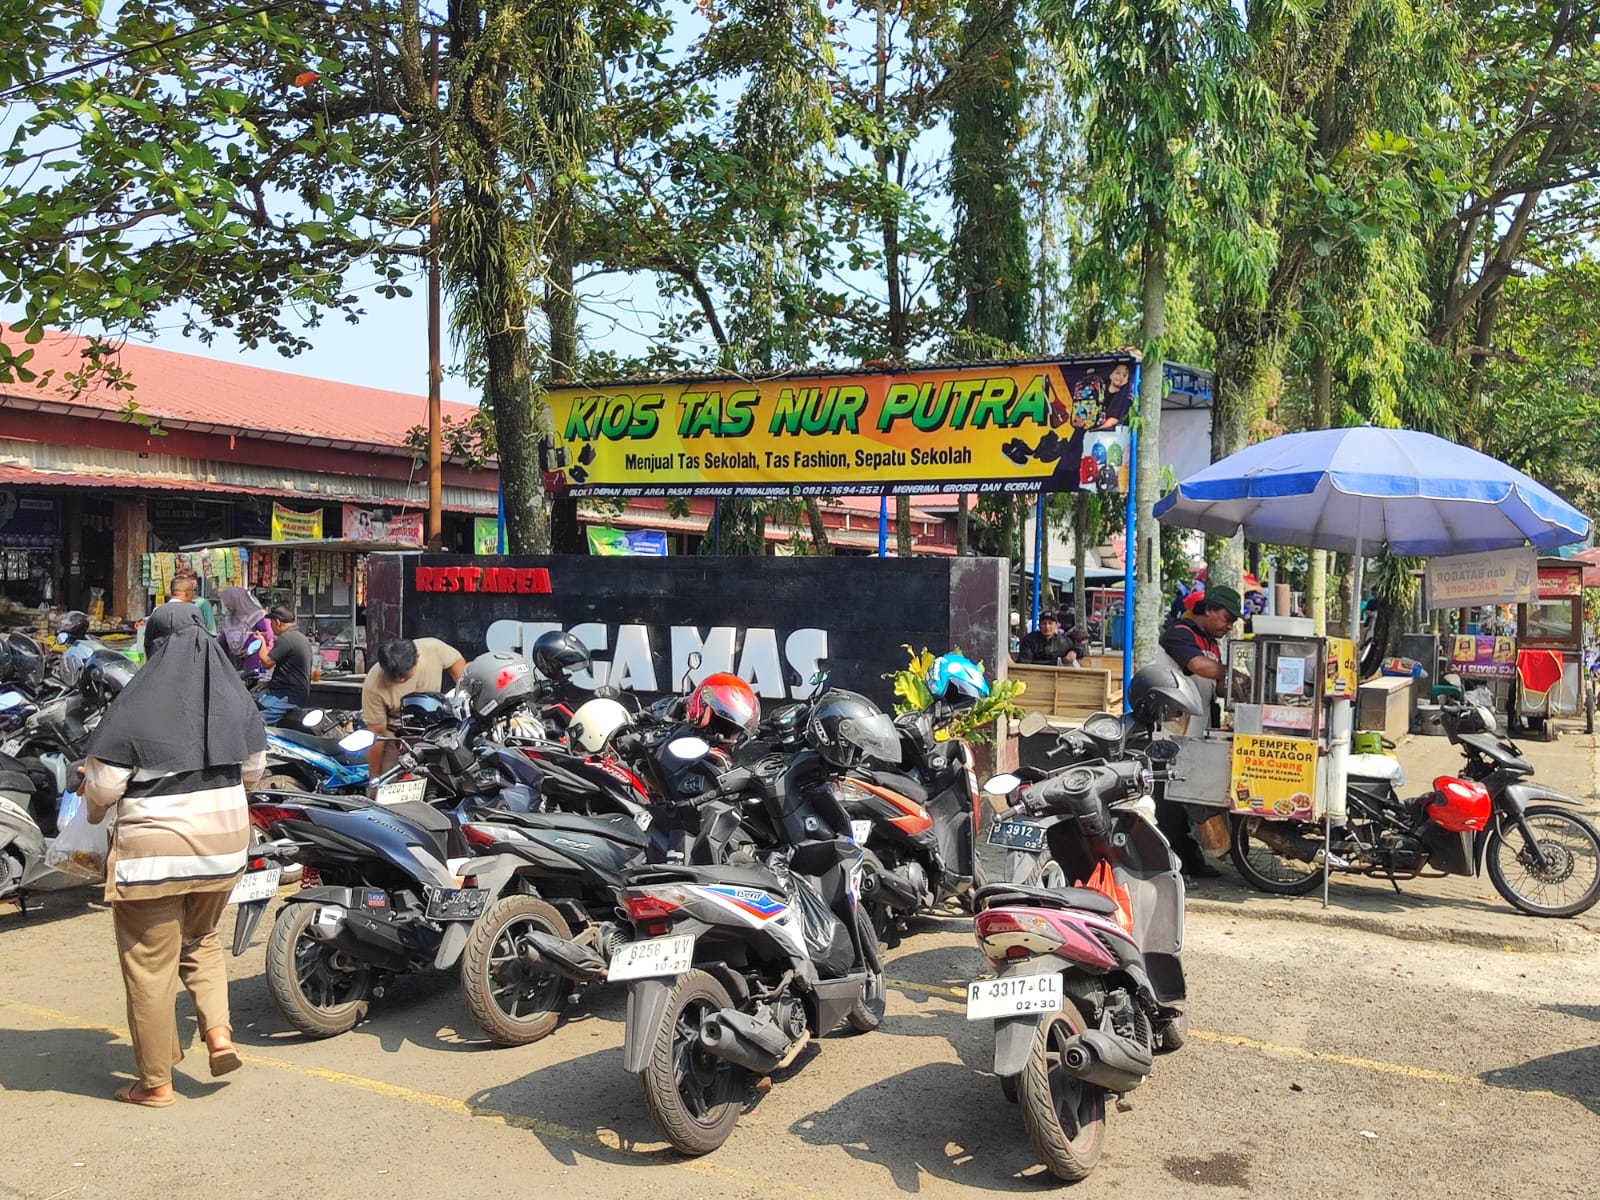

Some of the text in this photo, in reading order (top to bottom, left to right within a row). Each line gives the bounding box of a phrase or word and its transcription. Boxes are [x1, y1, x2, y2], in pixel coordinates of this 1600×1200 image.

[564, 374, 1048, 440] KIOS TAS NUR PUTRA
[625, 446, 972, 473] Menjual Tas Sekolah, Tas Fashion, Sepatu Sekolah
[593, 487, 621, 496] DEPAN
[622, 488, 642, 496] REST
[644, 488, 665, 496] AREA
[667, 487, 692, 496] PASAR
[694, 487, 733, 496] SEGAMAS
[734, 487, 790, 496] PURBALINGGA
[802, 486, 885, 495] 0821-3694-2521
[892, 484, 940, 494] MENERIMA
[943, 483, 978, 493] GROSIR
[980, 482, 1001, 492] DAN
[1004, 481, 1041, 491] ECERAN
[416, 566, 552, 593] REST AREA
[1468, 665, 1497, 674] GRATIS
[1251, 739, 1298, 751] PEMPEK
[1236, 747, 1313, 762] dan BATAGOR
[1245, 757, 1264, 766] Pak
[1006, 824, 1034, 838] 3912
[631, 943, 661, 960] 6258
[972, 977, 1057, 1000] R 3317 CL
